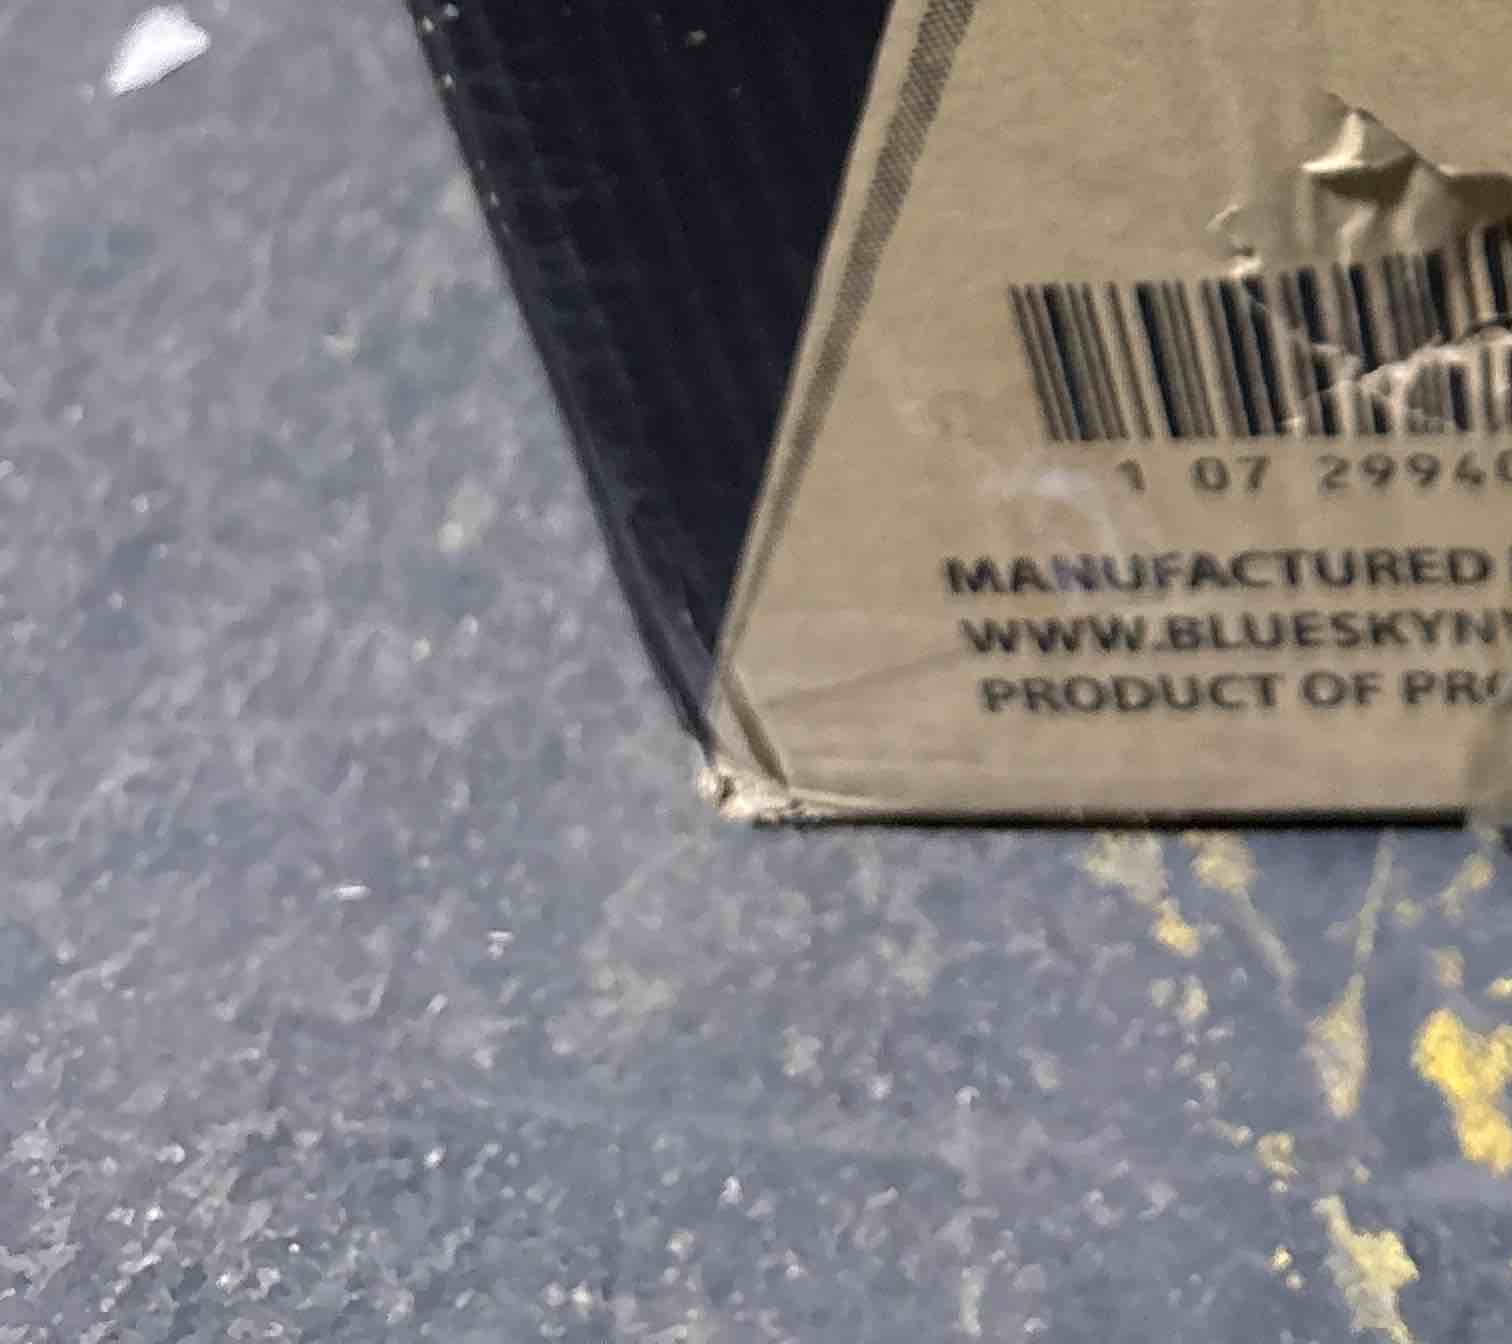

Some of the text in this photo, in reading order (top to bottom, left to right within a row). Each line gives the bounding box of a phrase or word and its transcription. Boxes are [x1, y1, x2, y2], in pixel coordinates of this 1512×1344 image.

[1191, 455, 1271, 494] 07
[944, 545, 1492, 593] MANUFACTURED
[979, 672, 1285, 714] PRODUCT
[1301, 671, 1383, 707] OF
